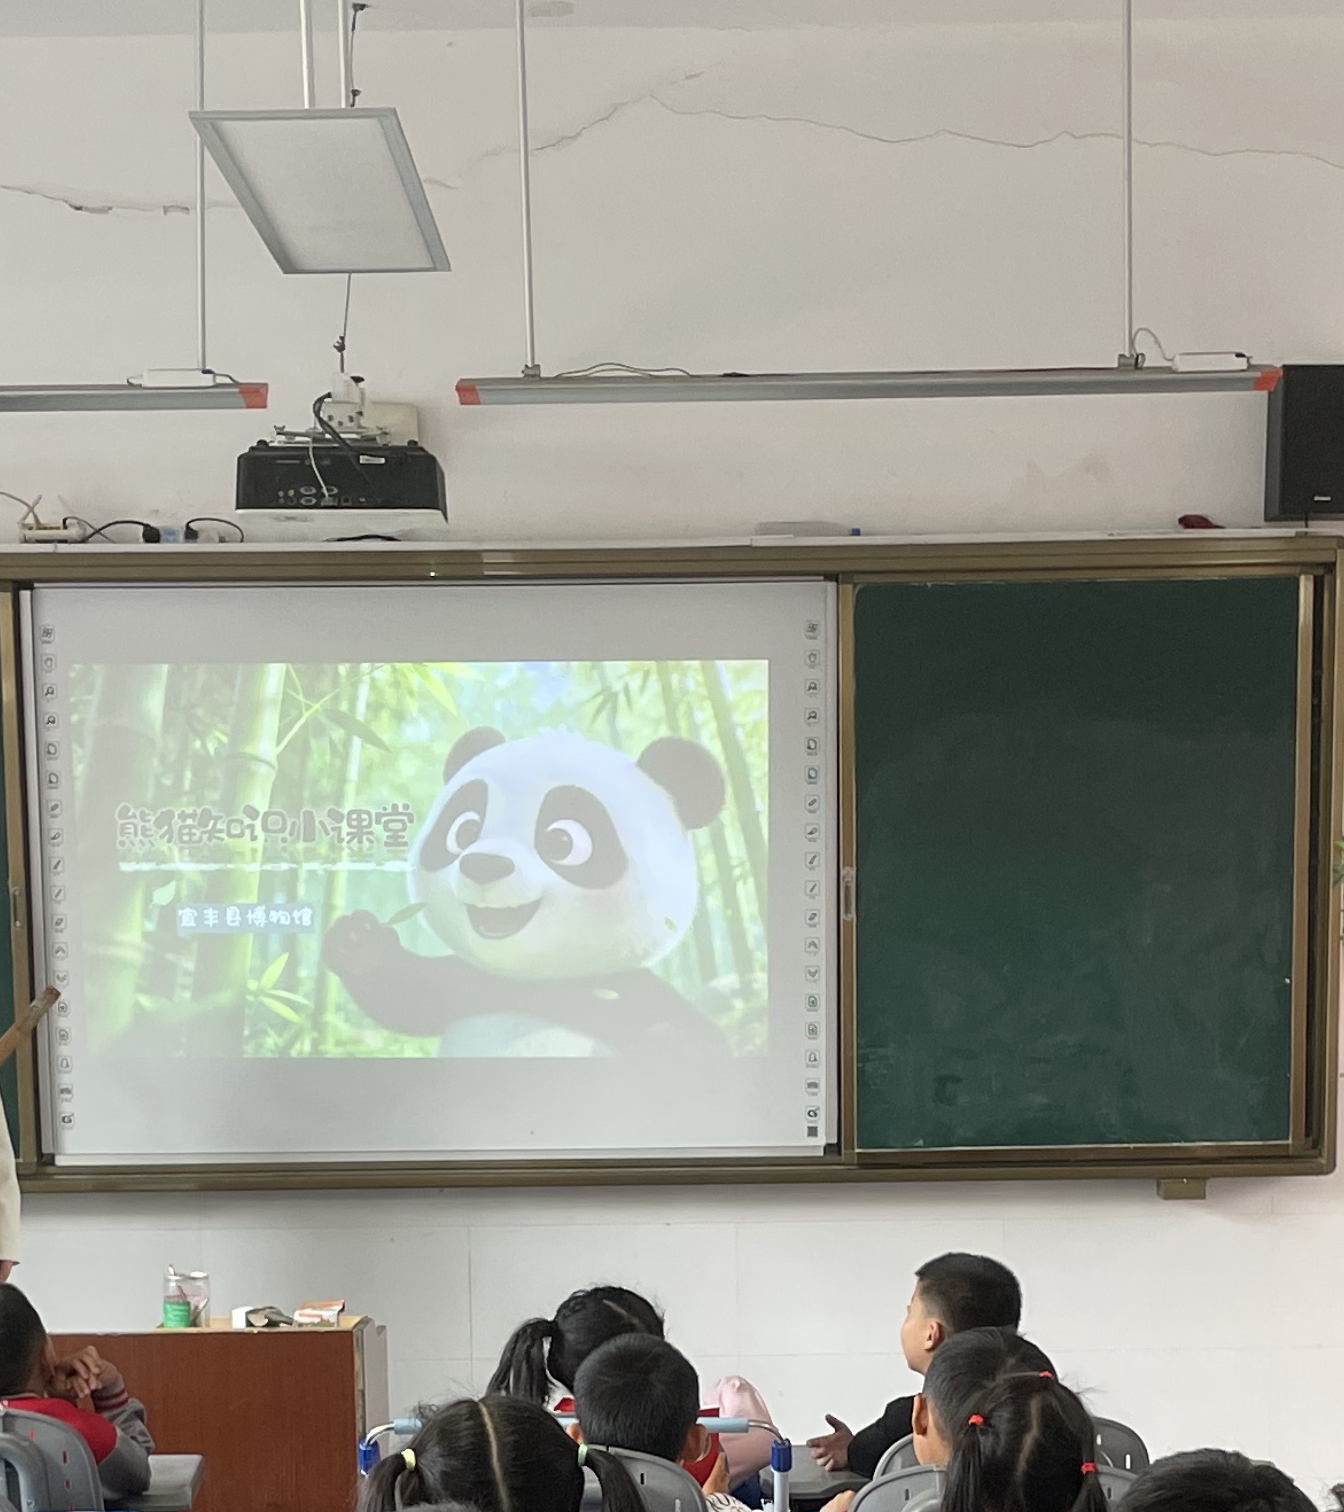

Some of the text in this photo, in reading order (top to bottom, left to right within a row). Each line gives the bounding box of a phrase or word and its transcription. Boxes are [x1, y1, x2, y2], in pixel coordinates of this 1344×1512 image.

[115, 803, 415, 850] 熊猫知识小课堂
[177, 906, 314, 928] 宜丰县博物馆
